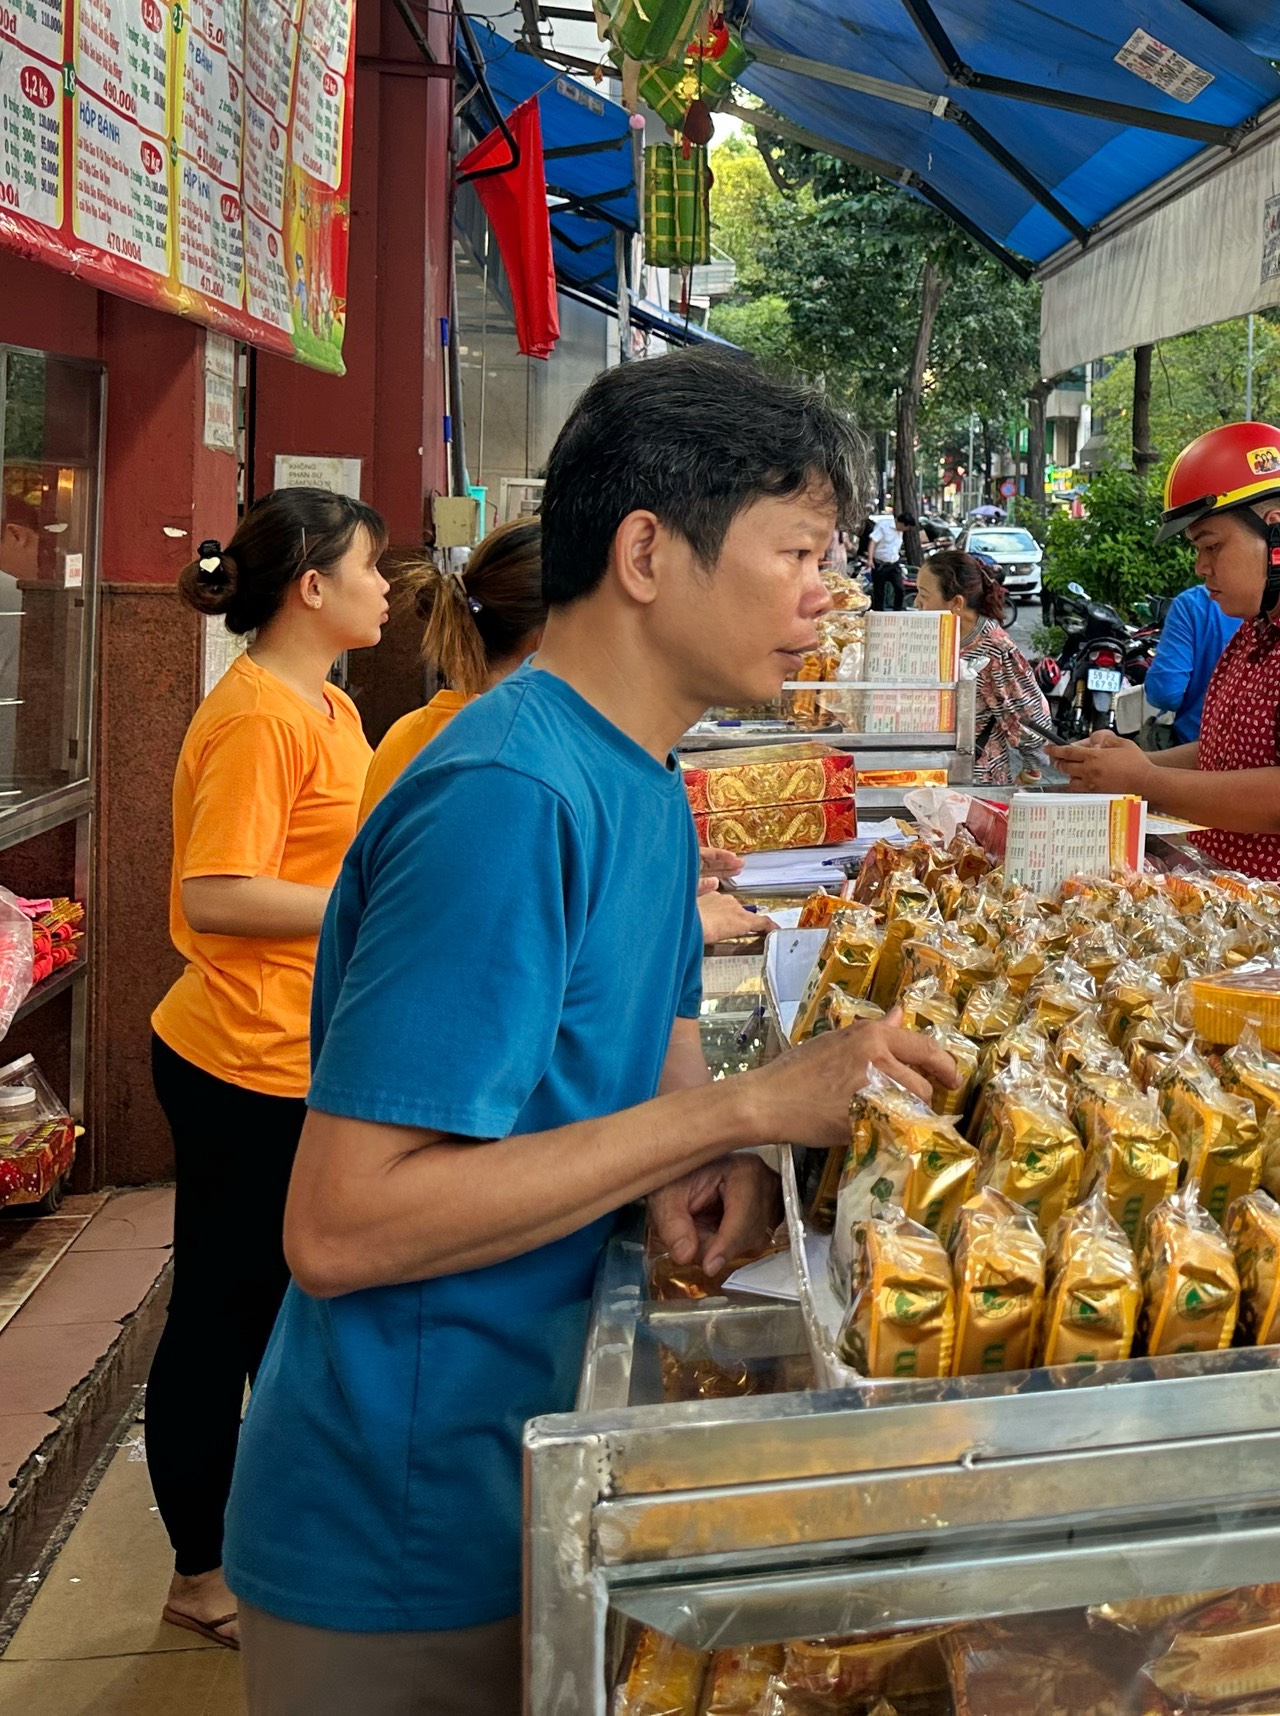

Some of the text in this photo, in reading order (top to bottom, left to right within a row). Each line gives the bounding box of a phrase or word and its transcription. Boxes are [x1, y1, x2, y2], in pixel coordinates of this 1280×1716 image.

[24, 71, 48, 106] 1,2 kg
[63, 67, 76, 92] 18
[79, 99, 120, 146] HỘP BÁNH
